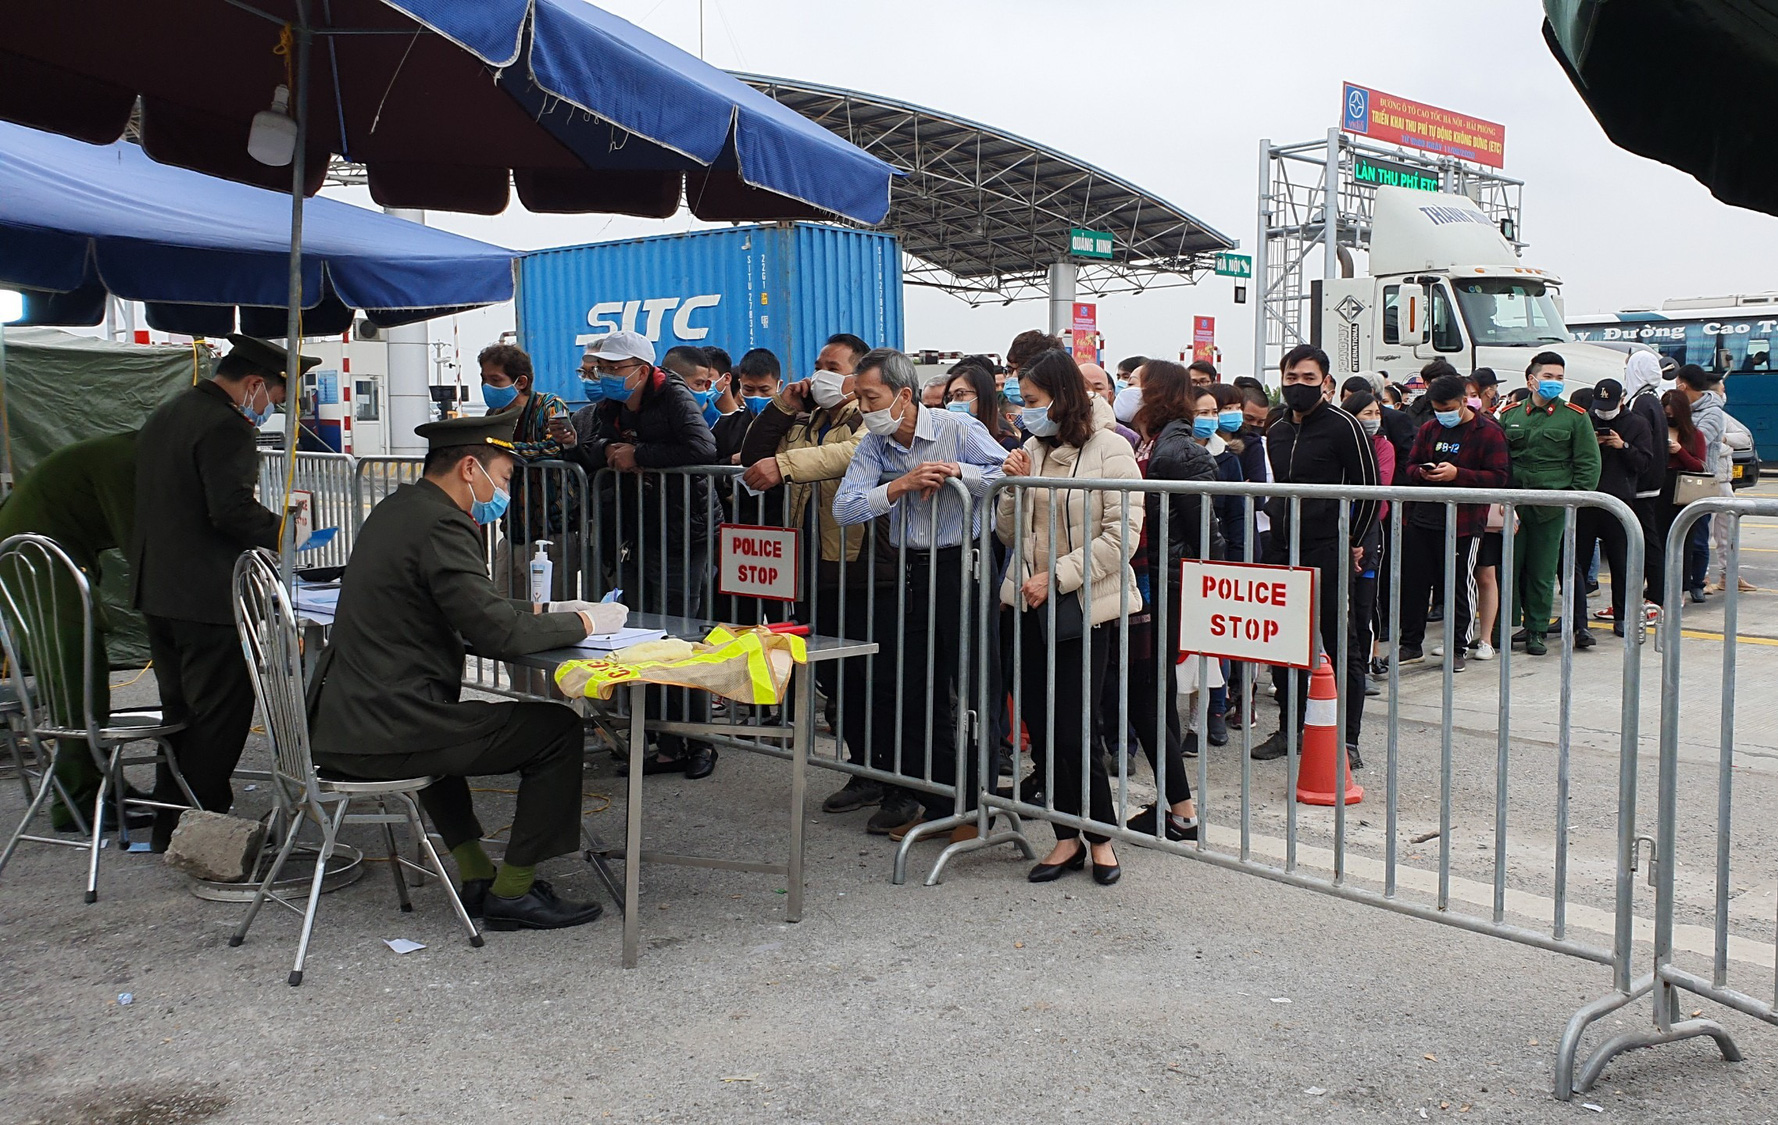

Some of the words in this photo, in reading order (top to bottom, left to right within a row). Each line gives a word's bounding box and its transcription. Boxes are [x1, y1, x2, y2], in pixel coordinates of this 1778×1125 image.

[1380, 98, 1401, 111] ĐƯỜNG
[1417, 108, 1430, 118] CAO
[1430, 110, 1442, 122] TỐC
[1372, 108, 1389, 126] TRIỂN
[1390, 114, 1404, 130] KHAI
[1405, 118, 1417, 133] THU
[1418, 121, 1428, 136] PHÍ
[1453, 131, 1473, 147] KHÔNG
[1489, 140, 1502, 155] (ETC)
[1355, 160, 1376, 182] LÀN
[1377, 168, 1399, 186] THU
[1400, 171, 1418, 190] PHÍ
[1420, 178, 1438, 192] ETC
[1072, 232, 1094, 252] QUẢNG
[1096, 238, 1112, 254] NINH
[1217, 256, 1227, 271] HÀ
[1229, 257, 1241, 275] NỘI
[575, 294, 722, 346] SITC
[1603, 324, 1686, 340] Đường
[1702, 321, 1750, 335] Cao
[1757, 320, 1778, 333] T
[732, 537, 782, 558] POLICE
[738, 564, 778, 585] STOP
[1202, 575, 1286, 607] POLICE
[1210, 614, 1279, 643] STOP
